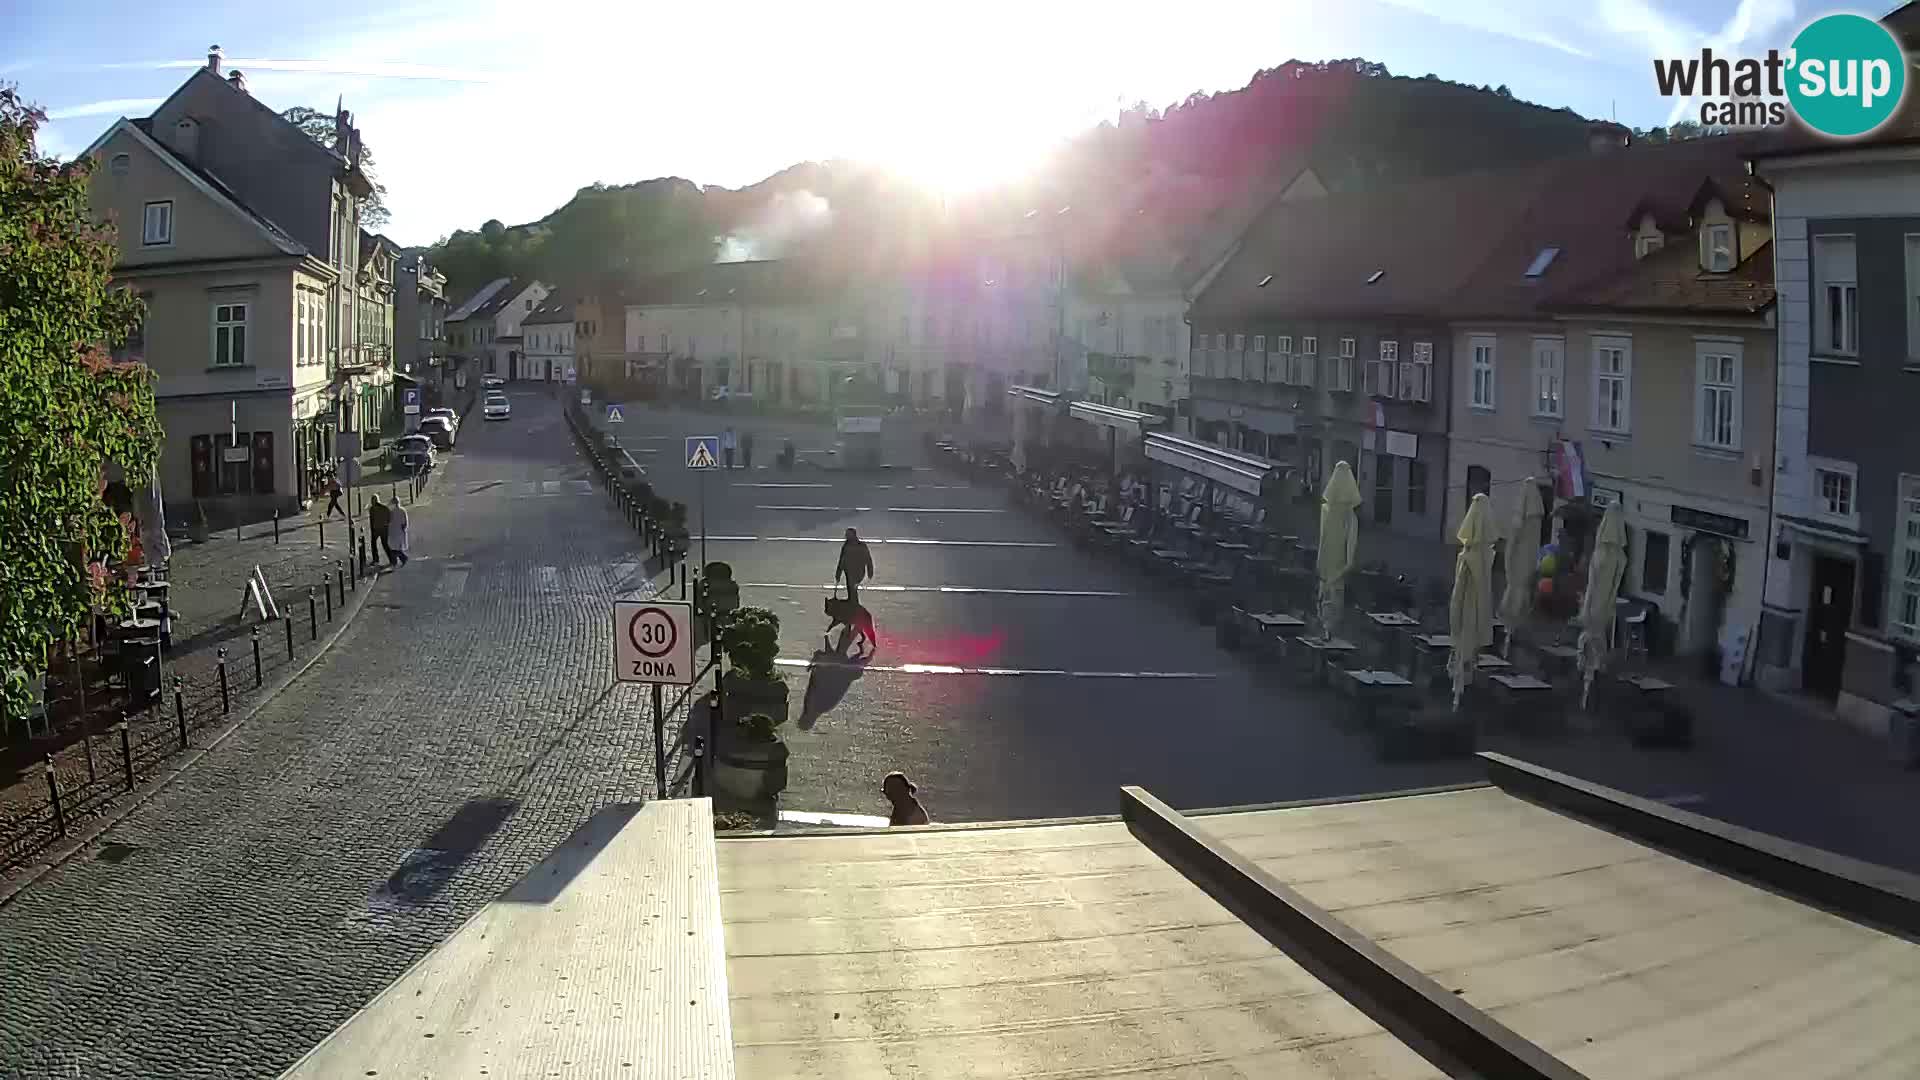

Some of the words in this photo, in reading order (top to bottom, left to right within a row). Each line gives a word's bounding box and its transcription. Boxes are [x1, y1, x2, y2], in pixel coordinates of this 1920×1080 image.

[408, 391, 416, 403] P
[641, 623, 666, 644] 30
[632, 660, 676, 677] ZONA
